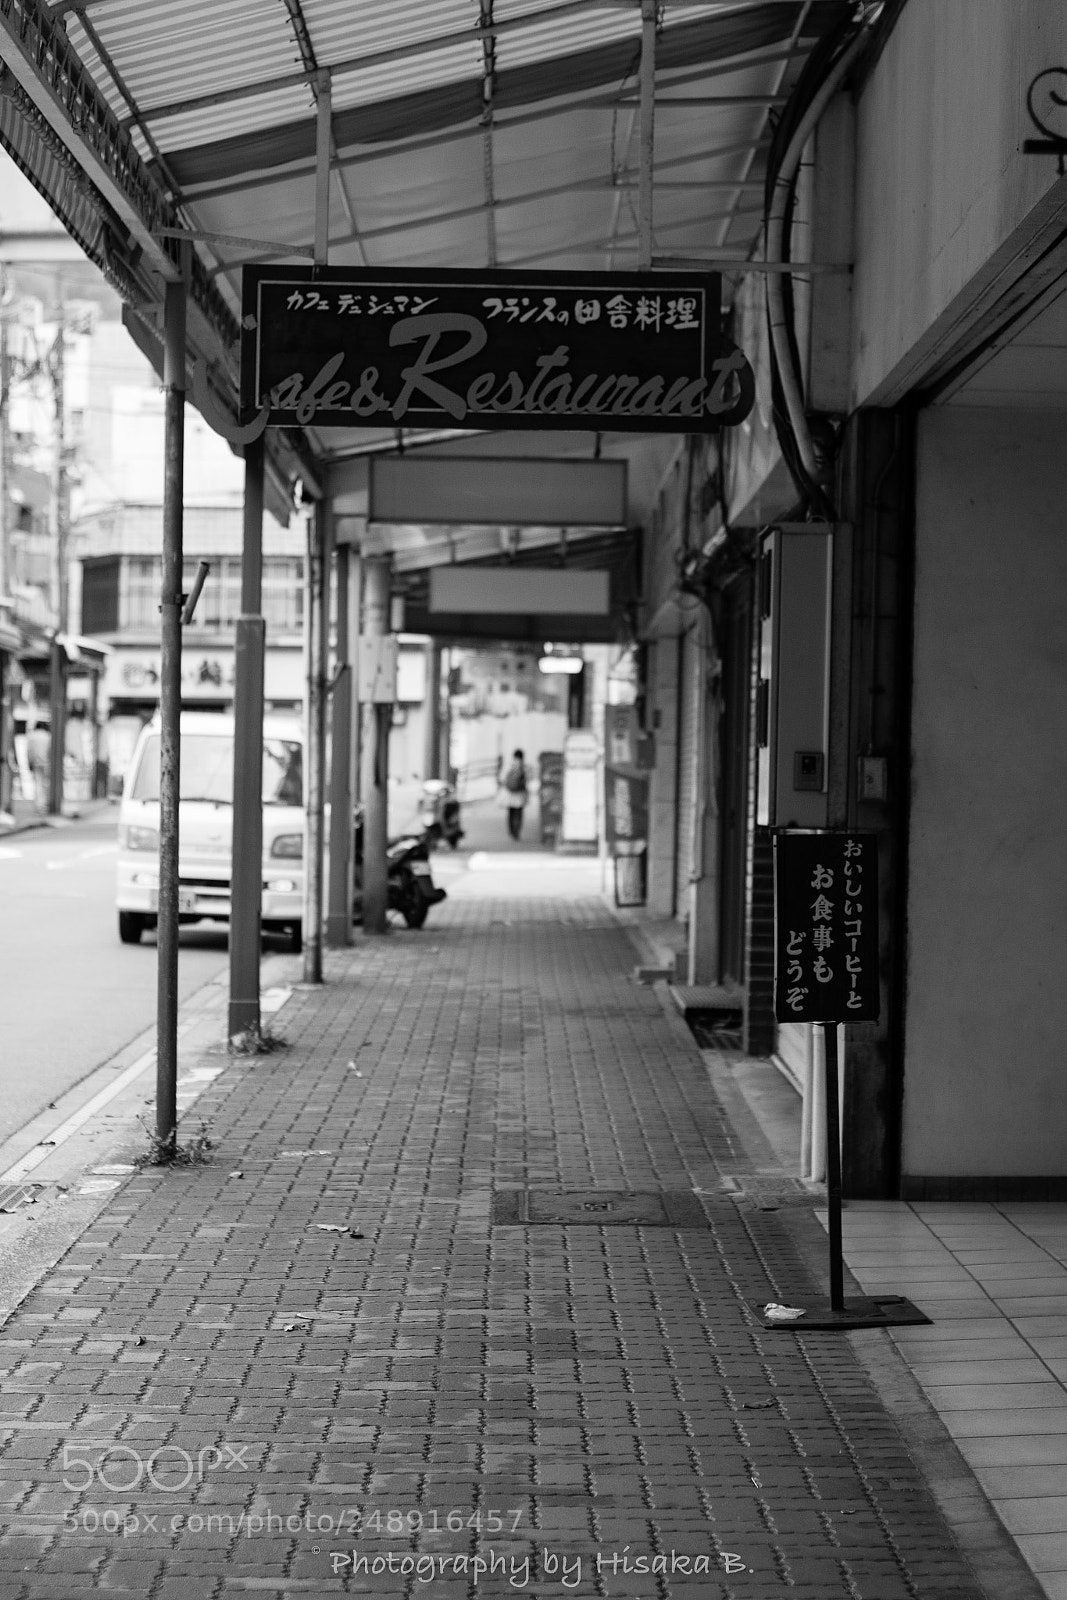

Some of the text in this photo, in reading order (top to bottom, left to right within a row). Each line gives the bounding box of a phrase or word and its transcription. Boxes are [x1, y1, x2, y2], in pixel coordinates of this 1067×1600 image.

[389, 312, 747, 421] Restaurant
[482, 294, 699, 333] フランスの田舎料理
[785, 930, 809, 1012] どうぞ
[810, 863, 835, 983] お食事も
[843, 839, 864, 1009] おいしいコーヒーと
